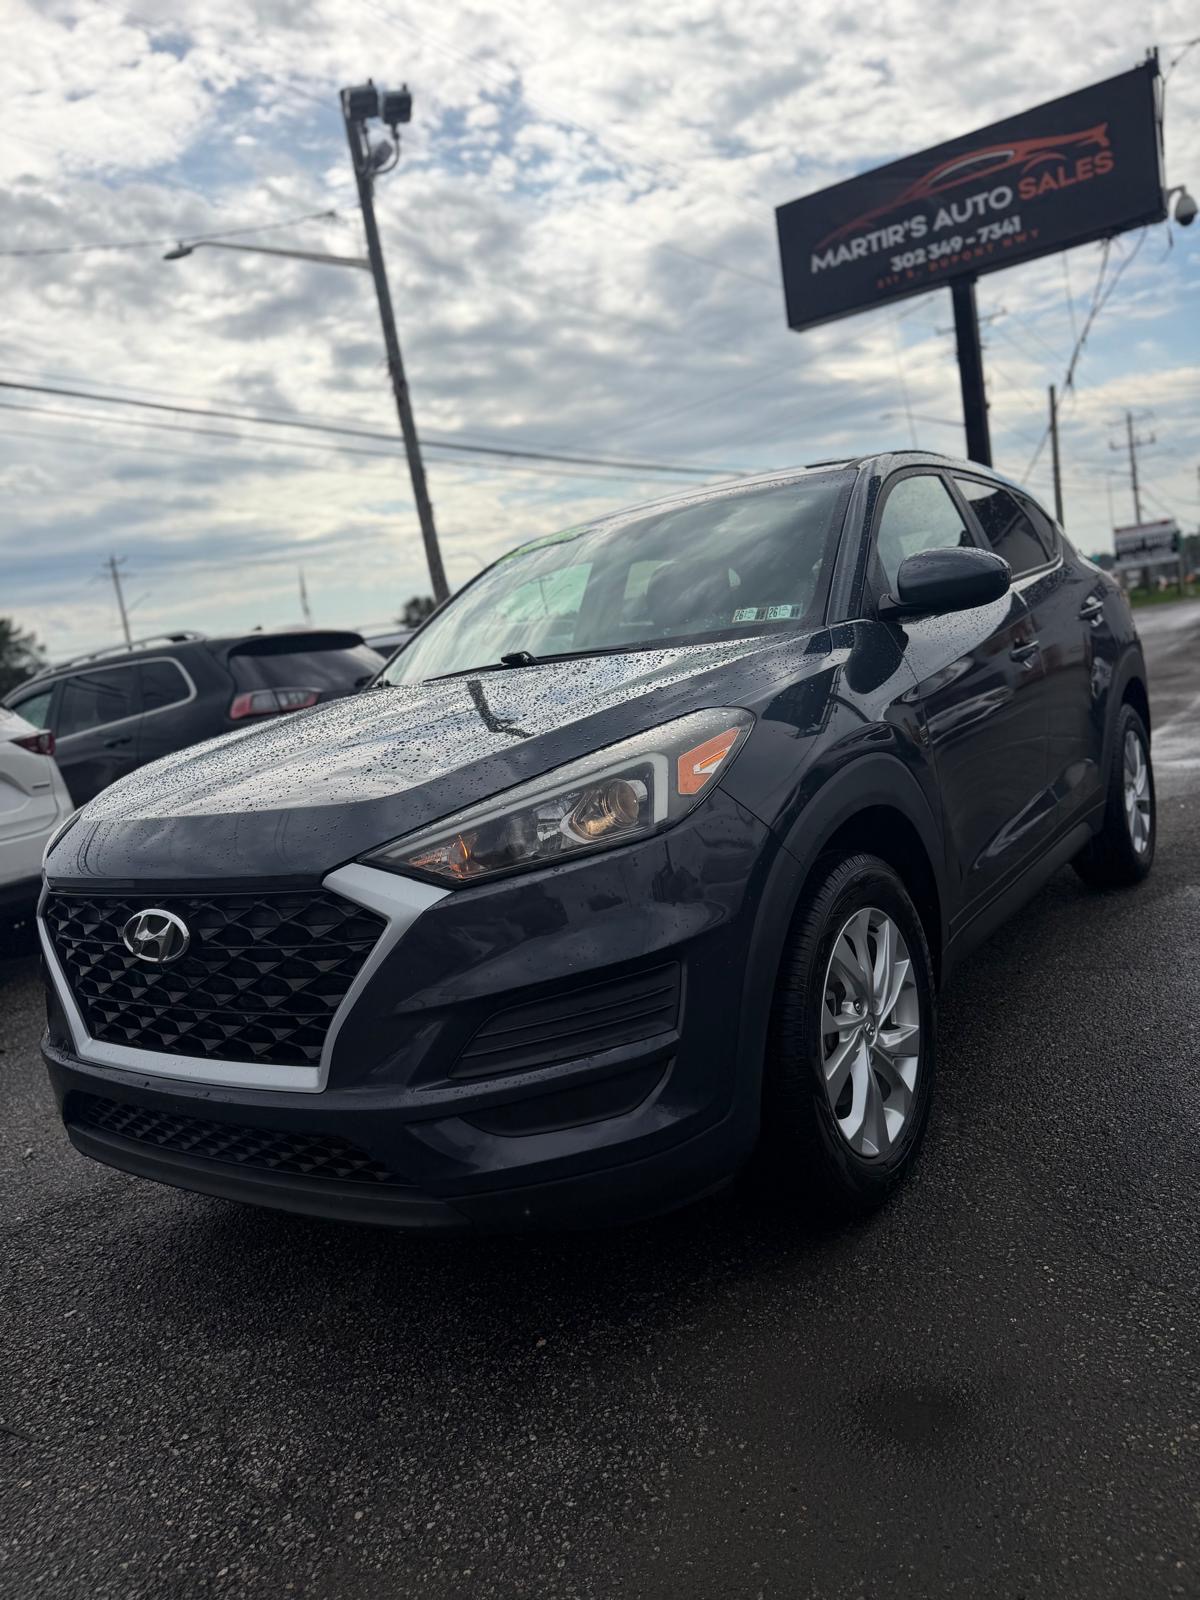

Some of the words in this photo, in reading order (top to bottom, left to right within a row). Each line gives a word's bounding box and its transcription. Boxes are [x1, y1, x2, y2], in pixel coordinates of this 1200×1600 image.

[810, 215, 928, 273] MARTIR'S
[933, 185, 1013, 231] AUTO
[1017, 151, 1115, 200] SALES
[890, 248, 926, 272] 302
